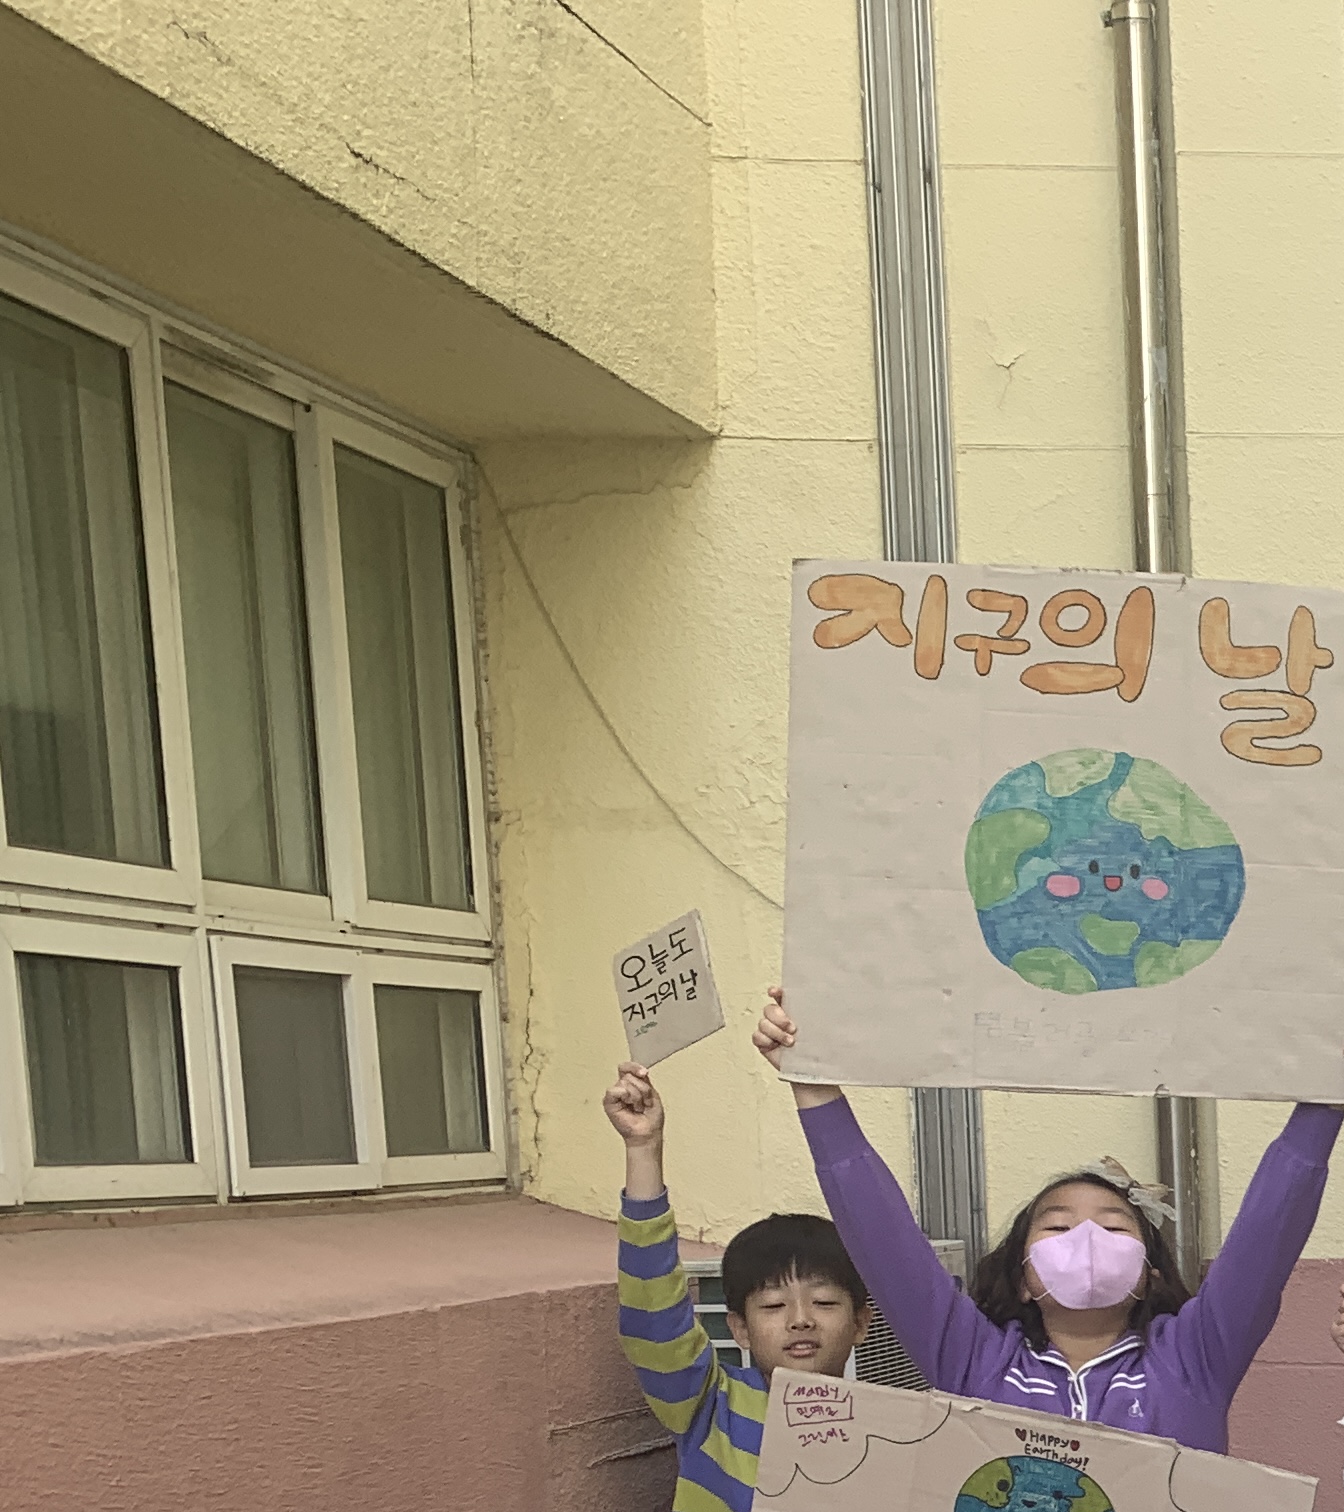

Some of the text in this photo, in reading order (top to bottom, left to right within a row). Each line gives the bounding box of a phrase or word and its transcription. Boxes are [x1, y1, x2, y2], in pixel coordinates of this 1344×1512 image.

[807, 572, 1334, 766] 지구의 날
[621, 927, 693, 992] 오늘도
[1030, 1430, 1070, 1448] Happy
